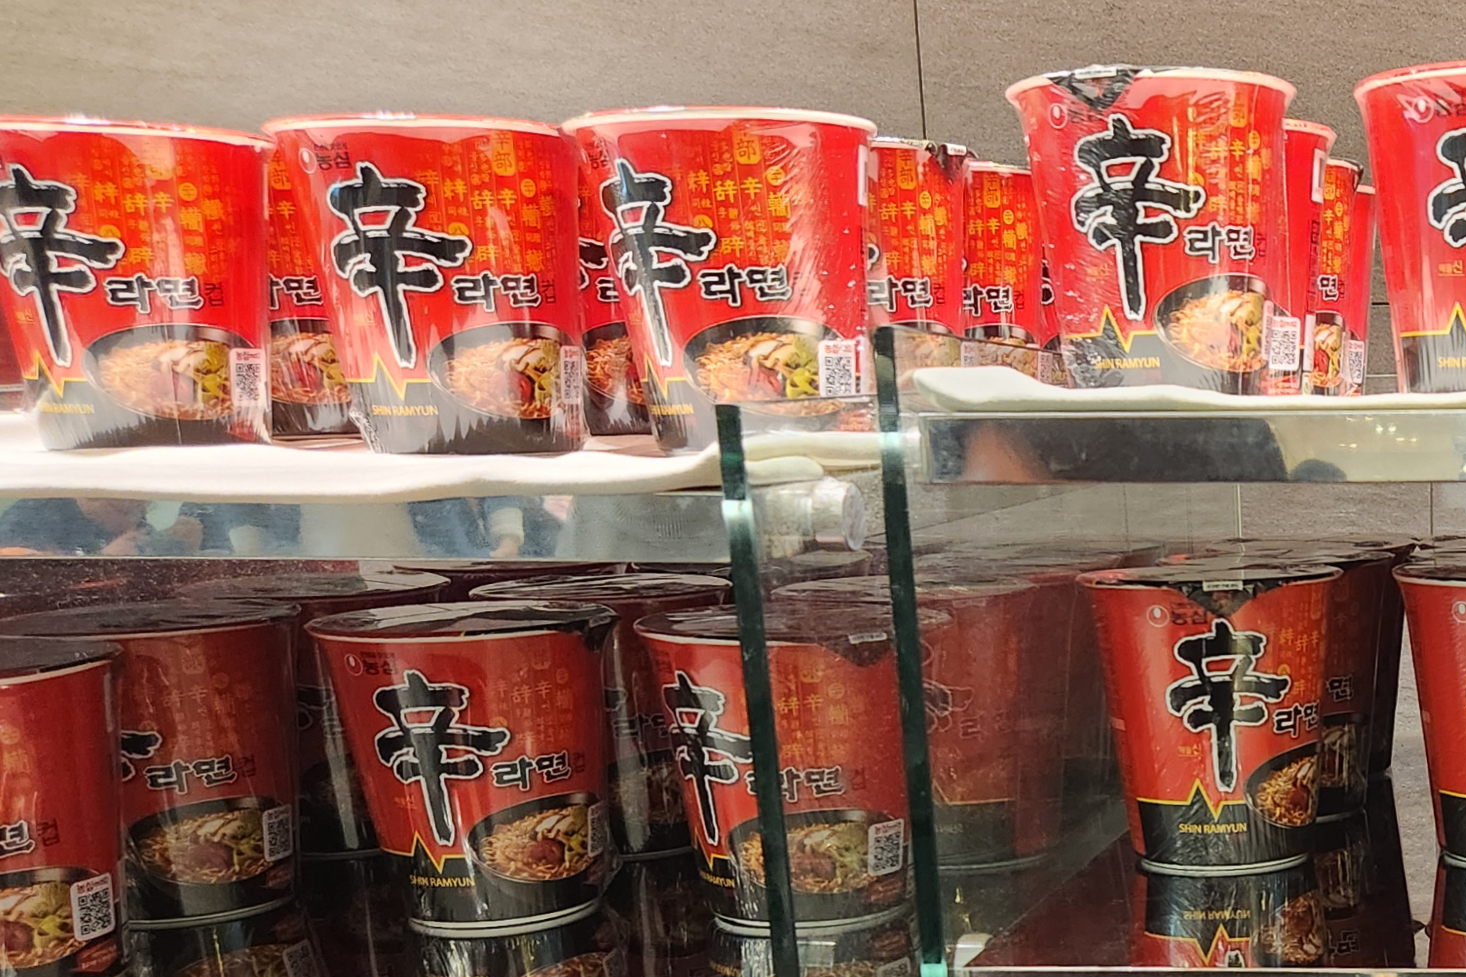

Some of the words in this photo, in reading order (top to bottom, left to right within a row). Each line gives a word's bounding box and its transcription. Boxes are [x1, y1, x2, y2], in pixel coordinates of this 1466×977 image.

[1071, 112, 1206, 321] 辛
[0, 163, 126, 368] 辛
[327, 160, 474, 370] 辛
[600, 156, 718, 368] 辛
[1316, 273, 1339, 301] 면
[1114, 356, 1161, 371] RAMYUN
[1437, 356, 1460, 369] SHIN
[372, 404, 392, 417] SHIN
[393, 403, 439, 417] RAMYUN
[1166, 617, 1291, 793] 辛
[1326, 675, 1354, 702] 면
[143, 753, 239, 795] 라면
[372, 669, 511, 846] 辛
[0, 818, 37, 860] 면
[1178, 822, 1202, 835] SHIN
[1203, 821, 1248, 835] RAMYUN
[429, 876, 476, 889] RAMYUN
